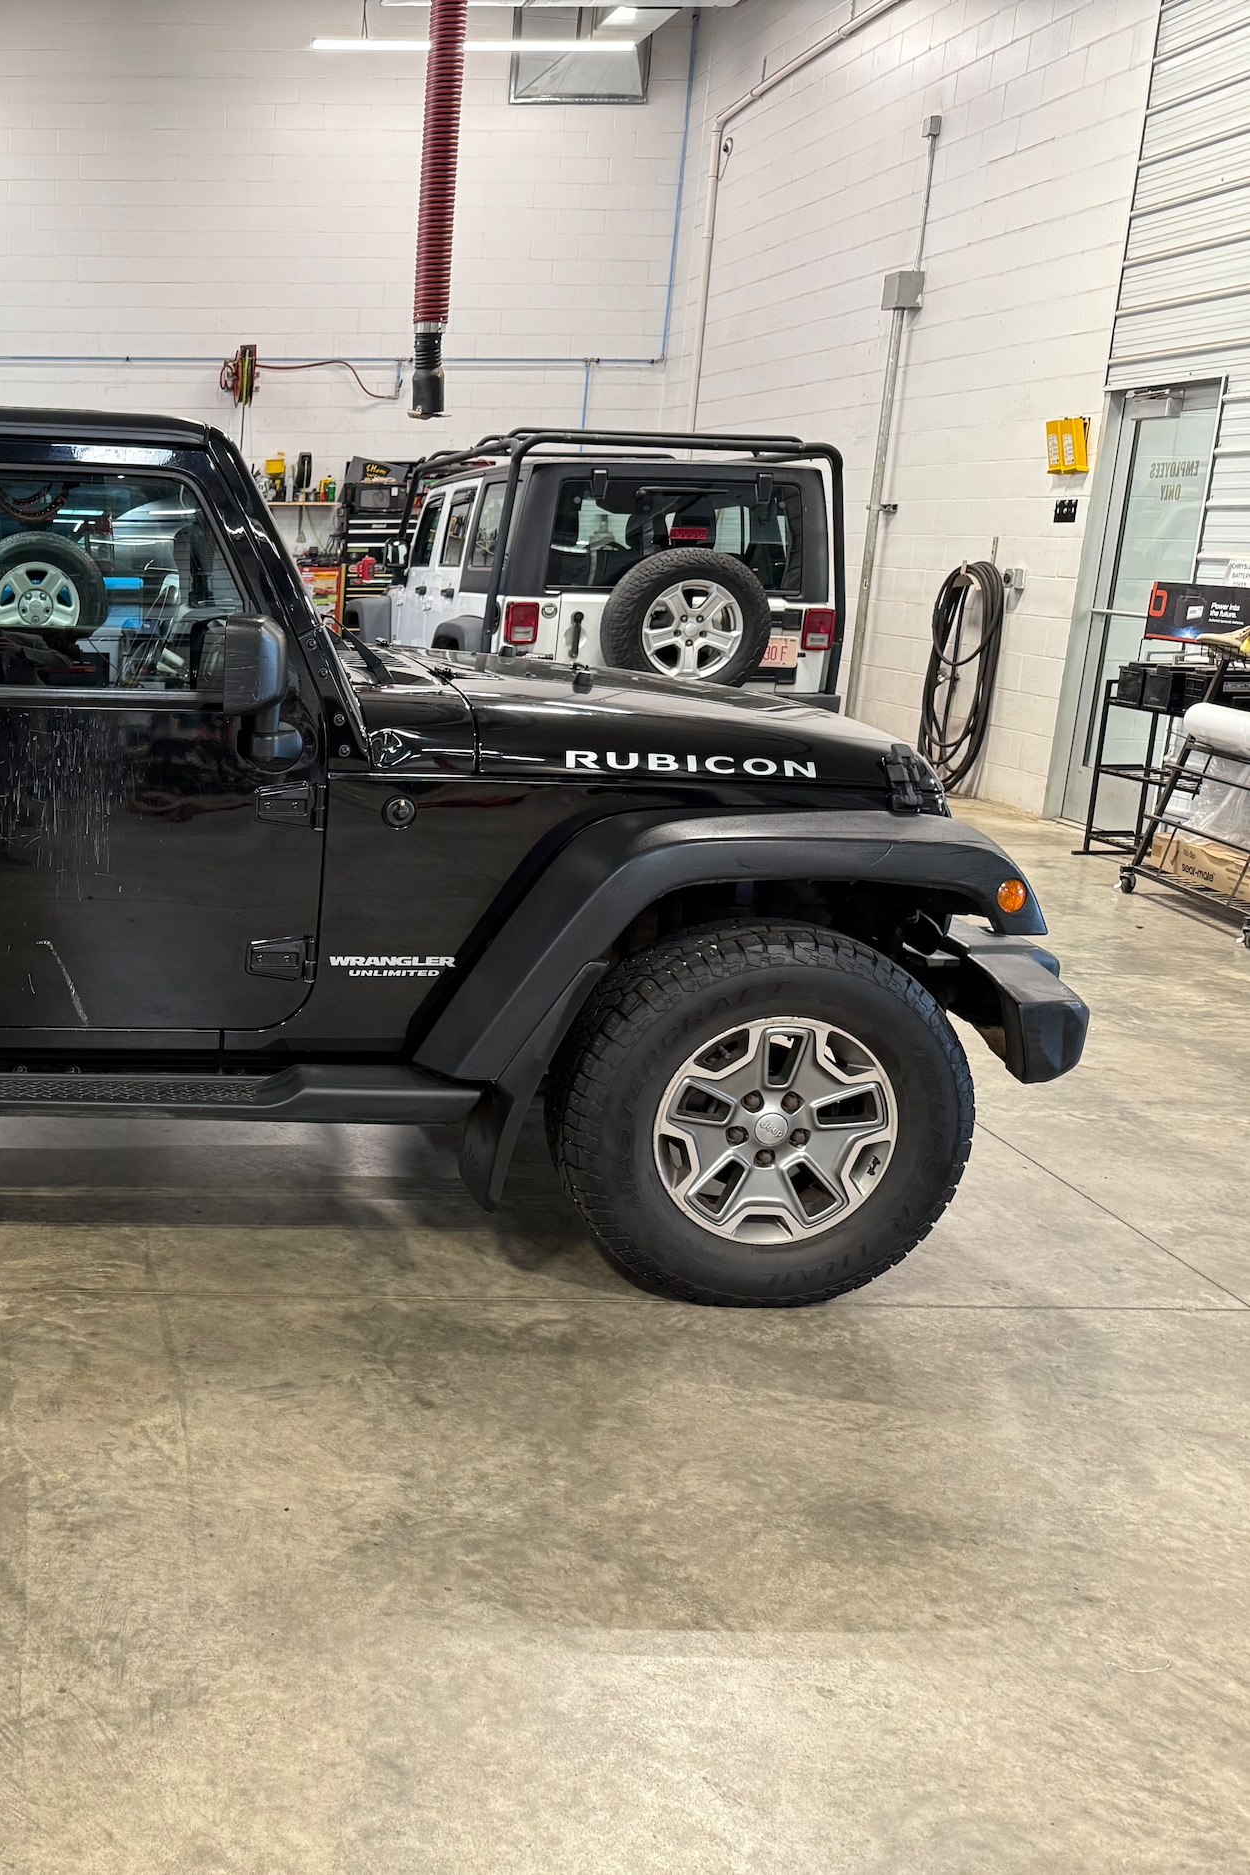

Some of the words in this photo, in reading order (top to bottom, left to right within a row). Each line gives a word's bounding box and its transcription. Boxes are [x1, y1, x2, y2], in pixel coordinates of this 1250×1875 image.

[1210, 602, 1229, 611] Power
[565, 750, 817, 779] RUBICON
[329, 956, 456, 967] WRANGLER
[760, 1121, 783, 1138] Jeep
